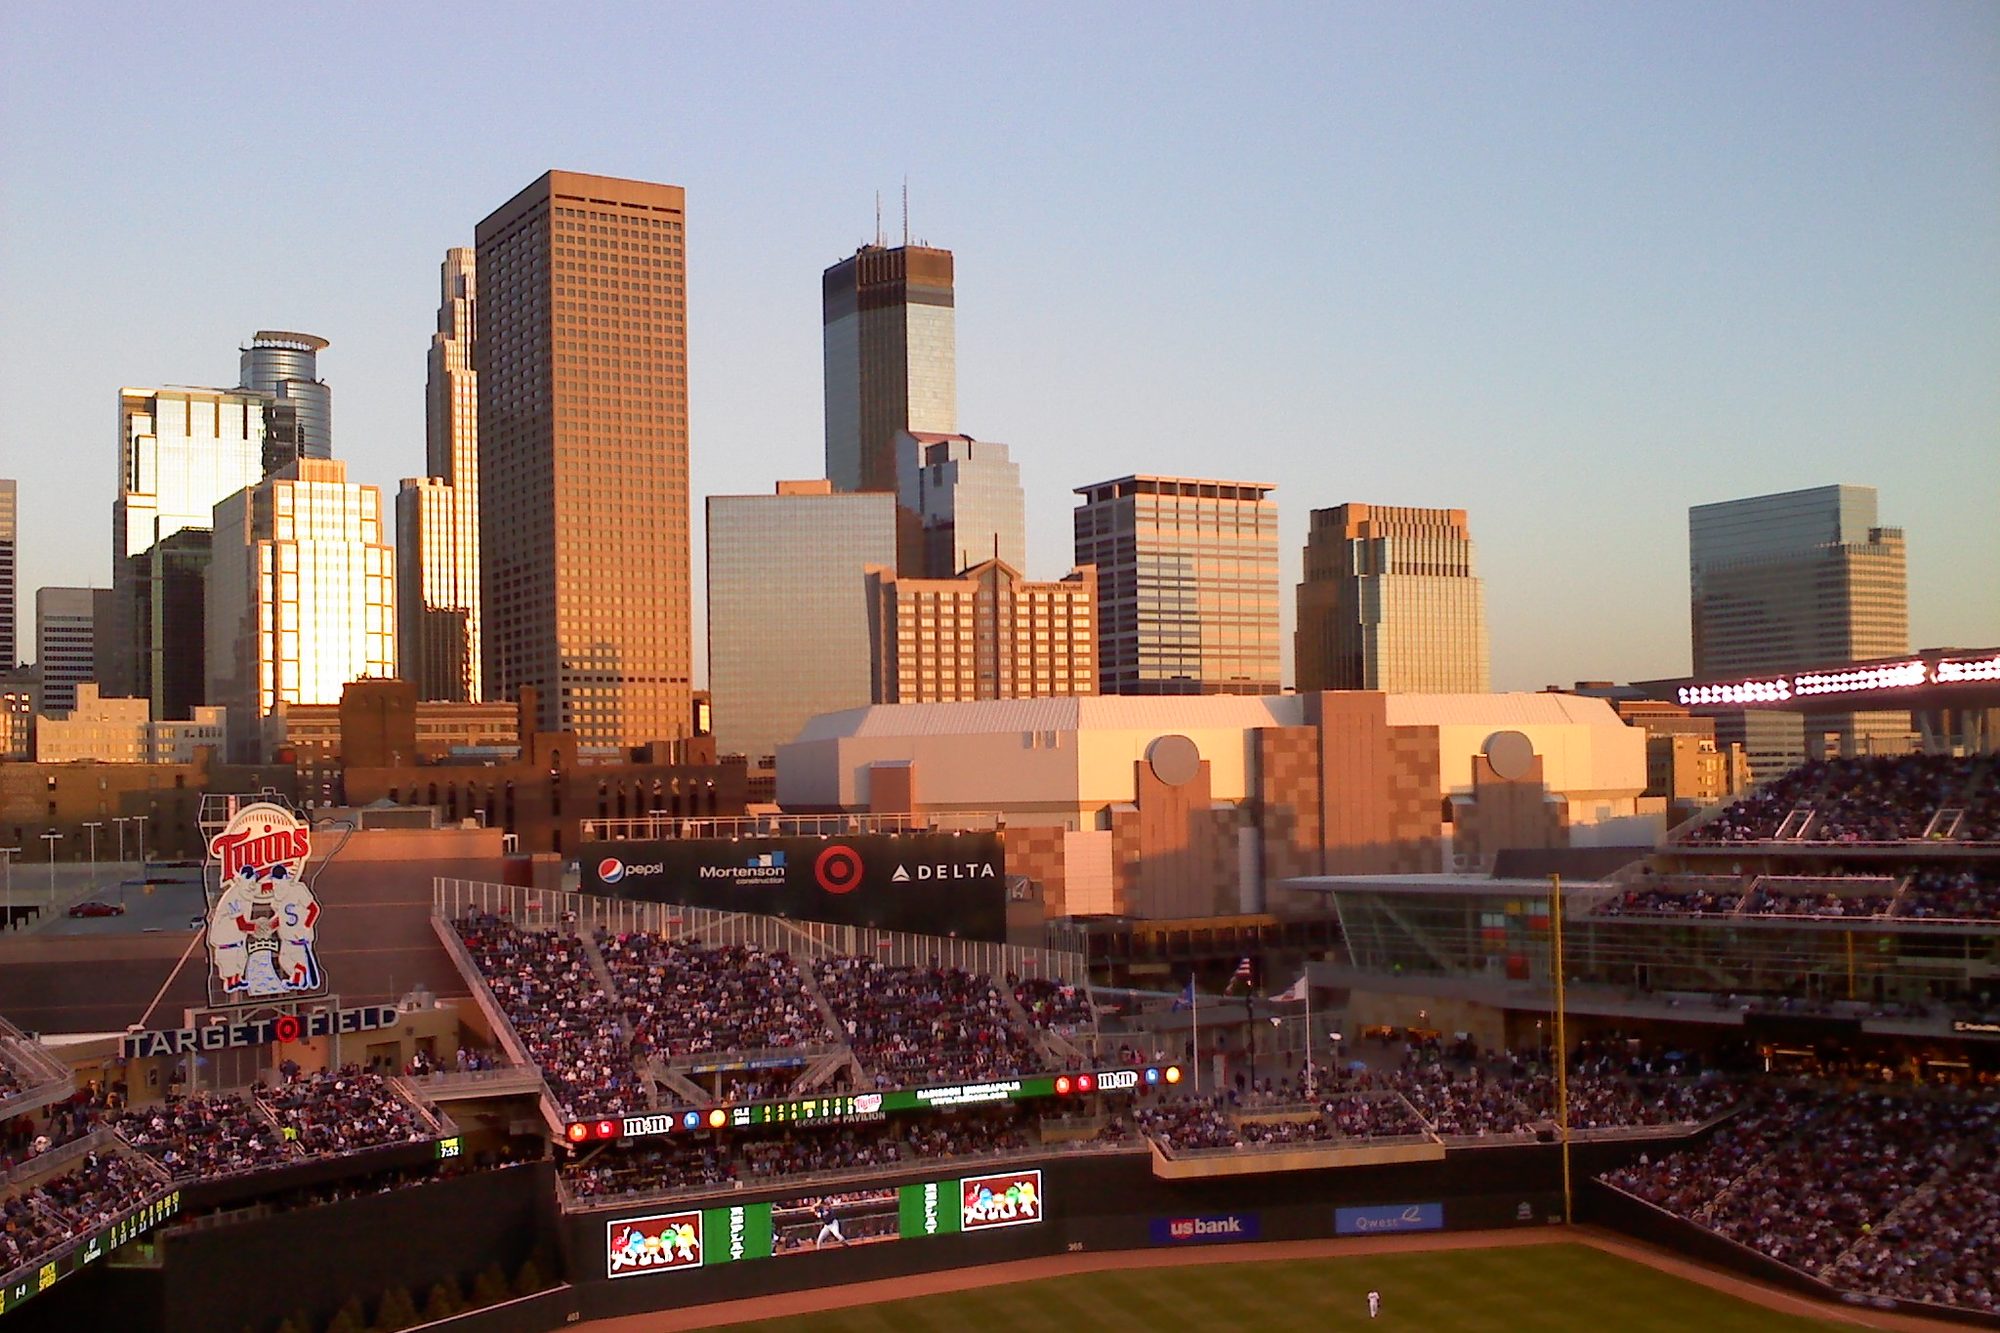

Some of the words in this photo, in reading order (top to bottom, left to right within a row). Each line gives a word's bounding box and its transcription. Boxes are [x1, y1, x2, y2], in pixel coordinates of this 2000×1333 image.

[212, 824, 309, 880] Twins
[625, 862, 664, 877] pepsi
[700, 866, 785, 878] Mortenson
[917, 863, 995, 880] DELTA
[735, 876, 785, 886] construction
[125, 1020, 271, 1057] TARGET
[307, 1005, 400, 1037] FIELD
[843, 1112, 886, 1124] PAVILION
[1356, 1216, 1399, 1230] Qwest
